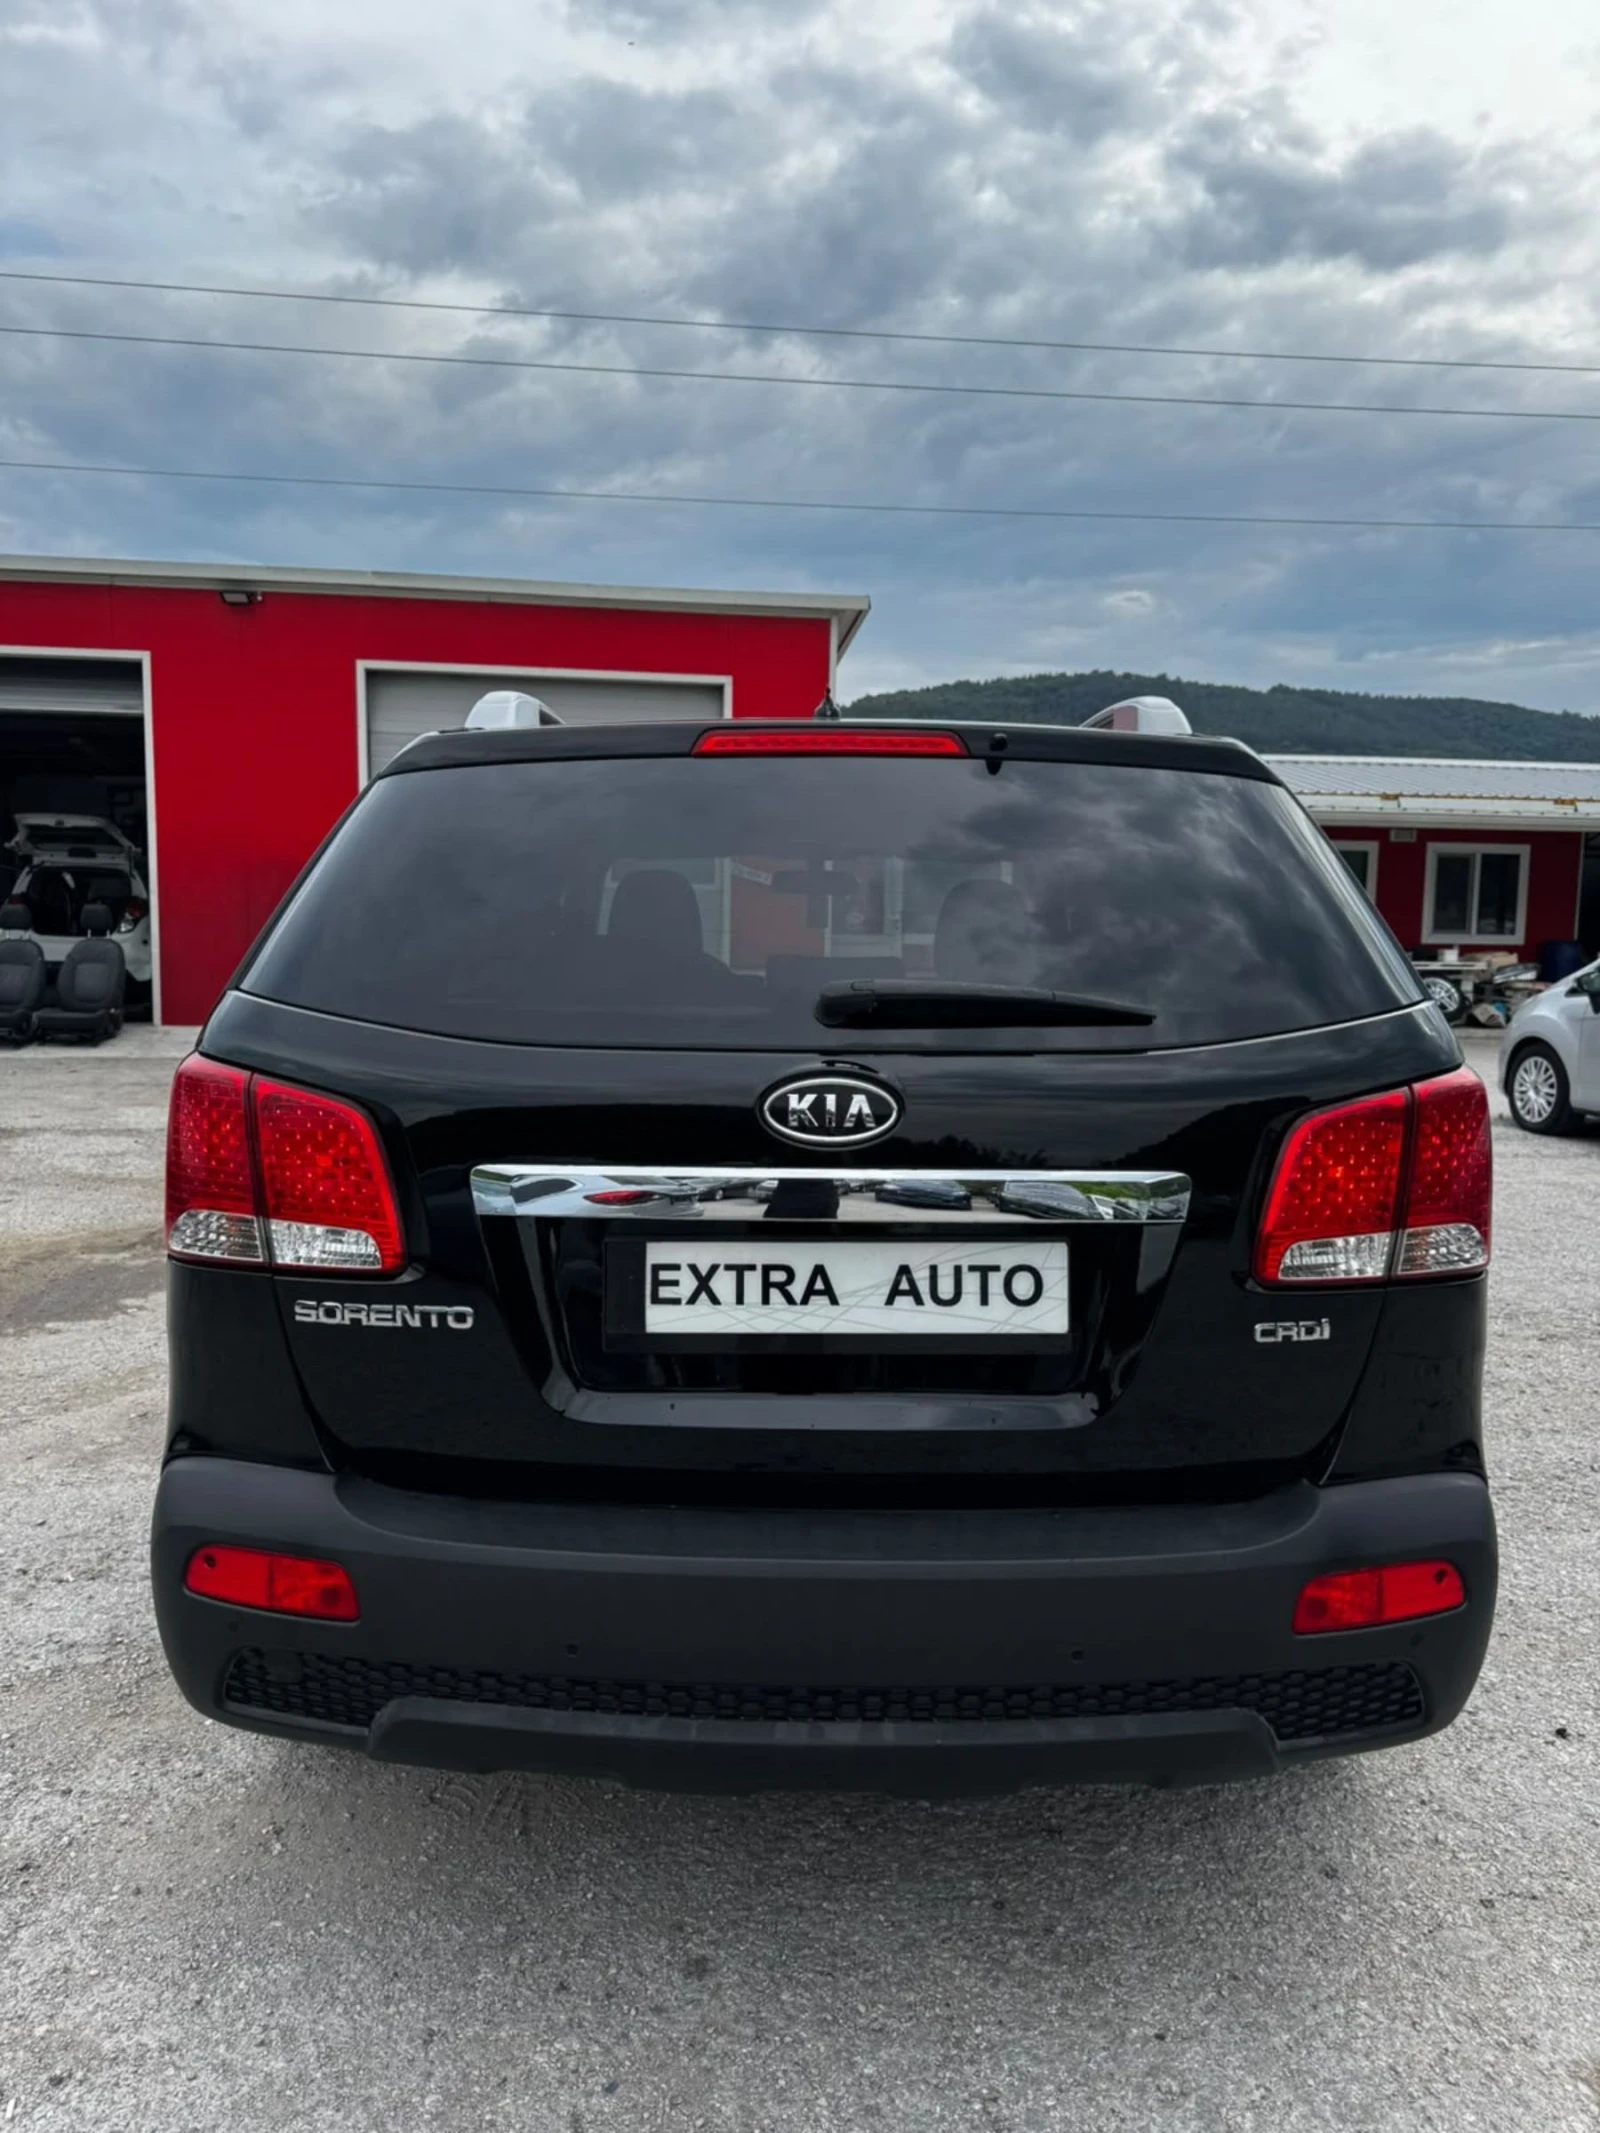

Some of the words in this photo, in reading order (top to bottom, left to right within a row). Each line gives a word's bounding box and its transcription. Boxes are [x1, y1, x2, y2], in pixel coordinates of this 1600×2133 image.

[786, 1093, 877, 1127] KIA
[649, 1263, 840, 1307] EXTRA
[884, 1263, 1043, 1307] AUTO
[294, 1299, 474, 1329] SORENTO
[1254, 1318, 1330, 1342] CRDi
